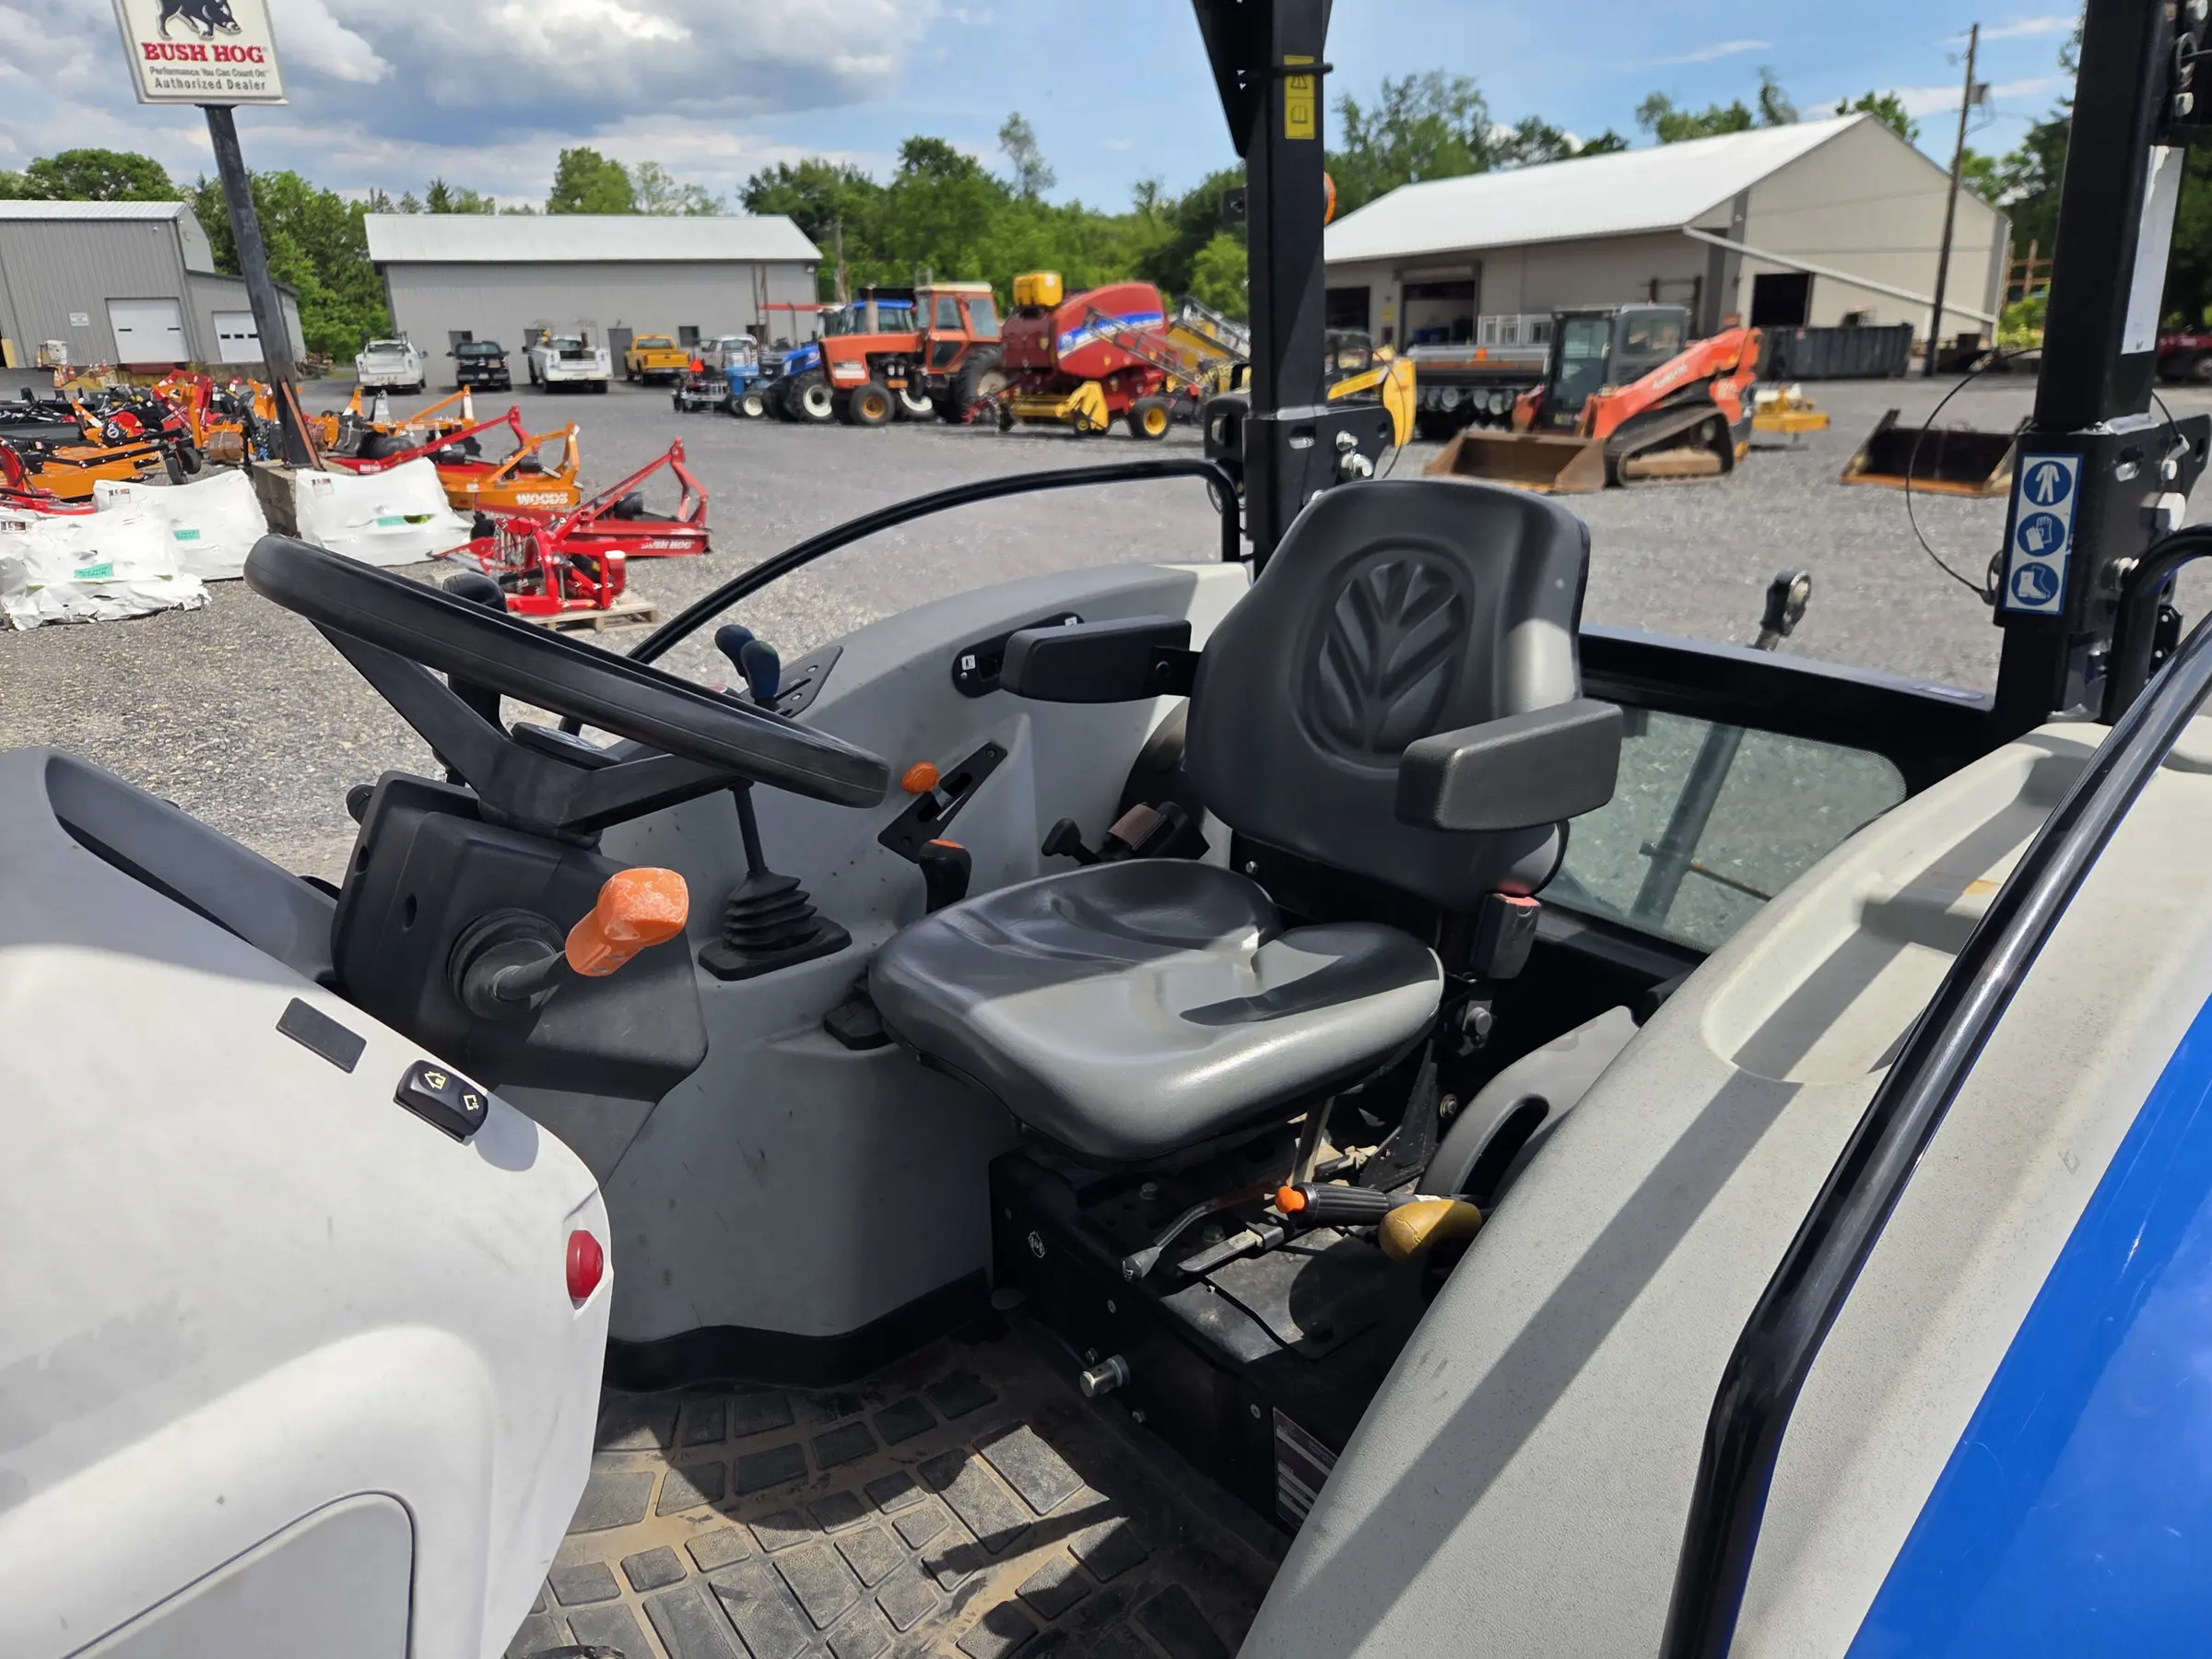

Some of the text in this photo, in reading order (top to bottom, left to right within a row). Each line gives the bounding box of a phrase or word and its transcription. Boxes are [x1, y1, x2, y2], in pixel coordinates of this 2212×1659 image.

[141, 42, 265, 64] BUSH HOG
[149, 66, 200, 76] Performance
[202, 67, 215, 76] You
[216, 68, 231, 77] Can
[232, 68, 253, 77] Count
[155, 77, 265, 90] Authorized Dealer
[515, 491, 569, 505] WOODS
